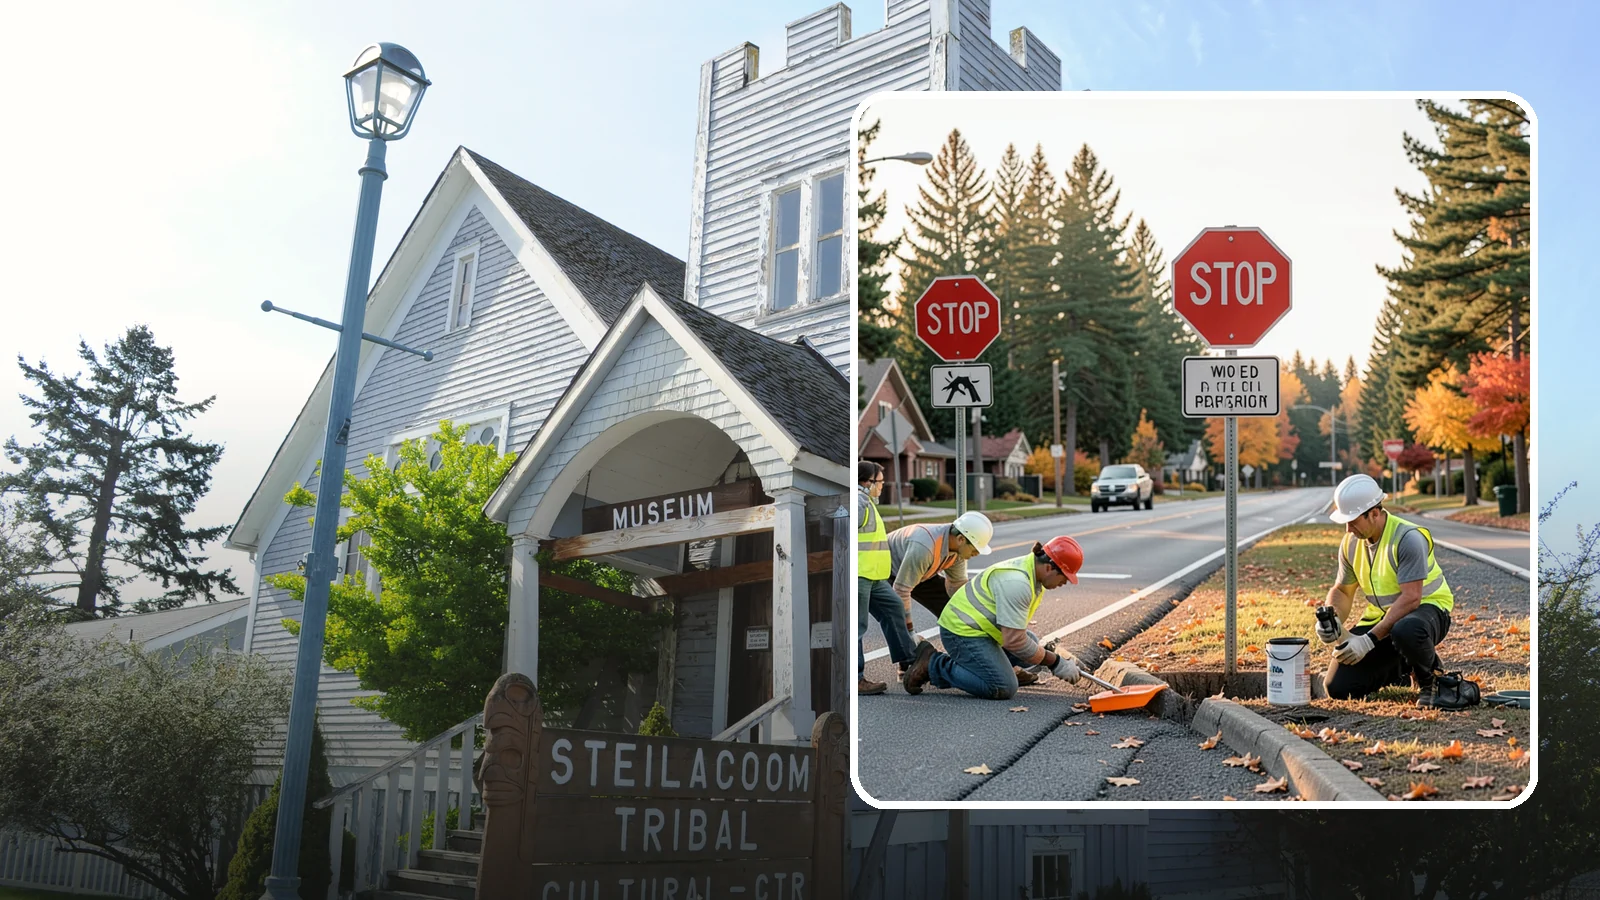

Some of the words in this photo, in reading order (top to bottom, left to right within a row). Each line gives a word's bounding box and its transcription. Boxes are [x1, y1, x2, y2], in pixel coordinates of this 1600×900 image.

[1190, 261, 1277, 305] STOP
[927, 301, 990, 335] STOP
[613, 491, 713, 530] MUSEUM
[551, 738, 809, 792] STEILACOOM
[615, 806, 758, 852] TRIBAL
